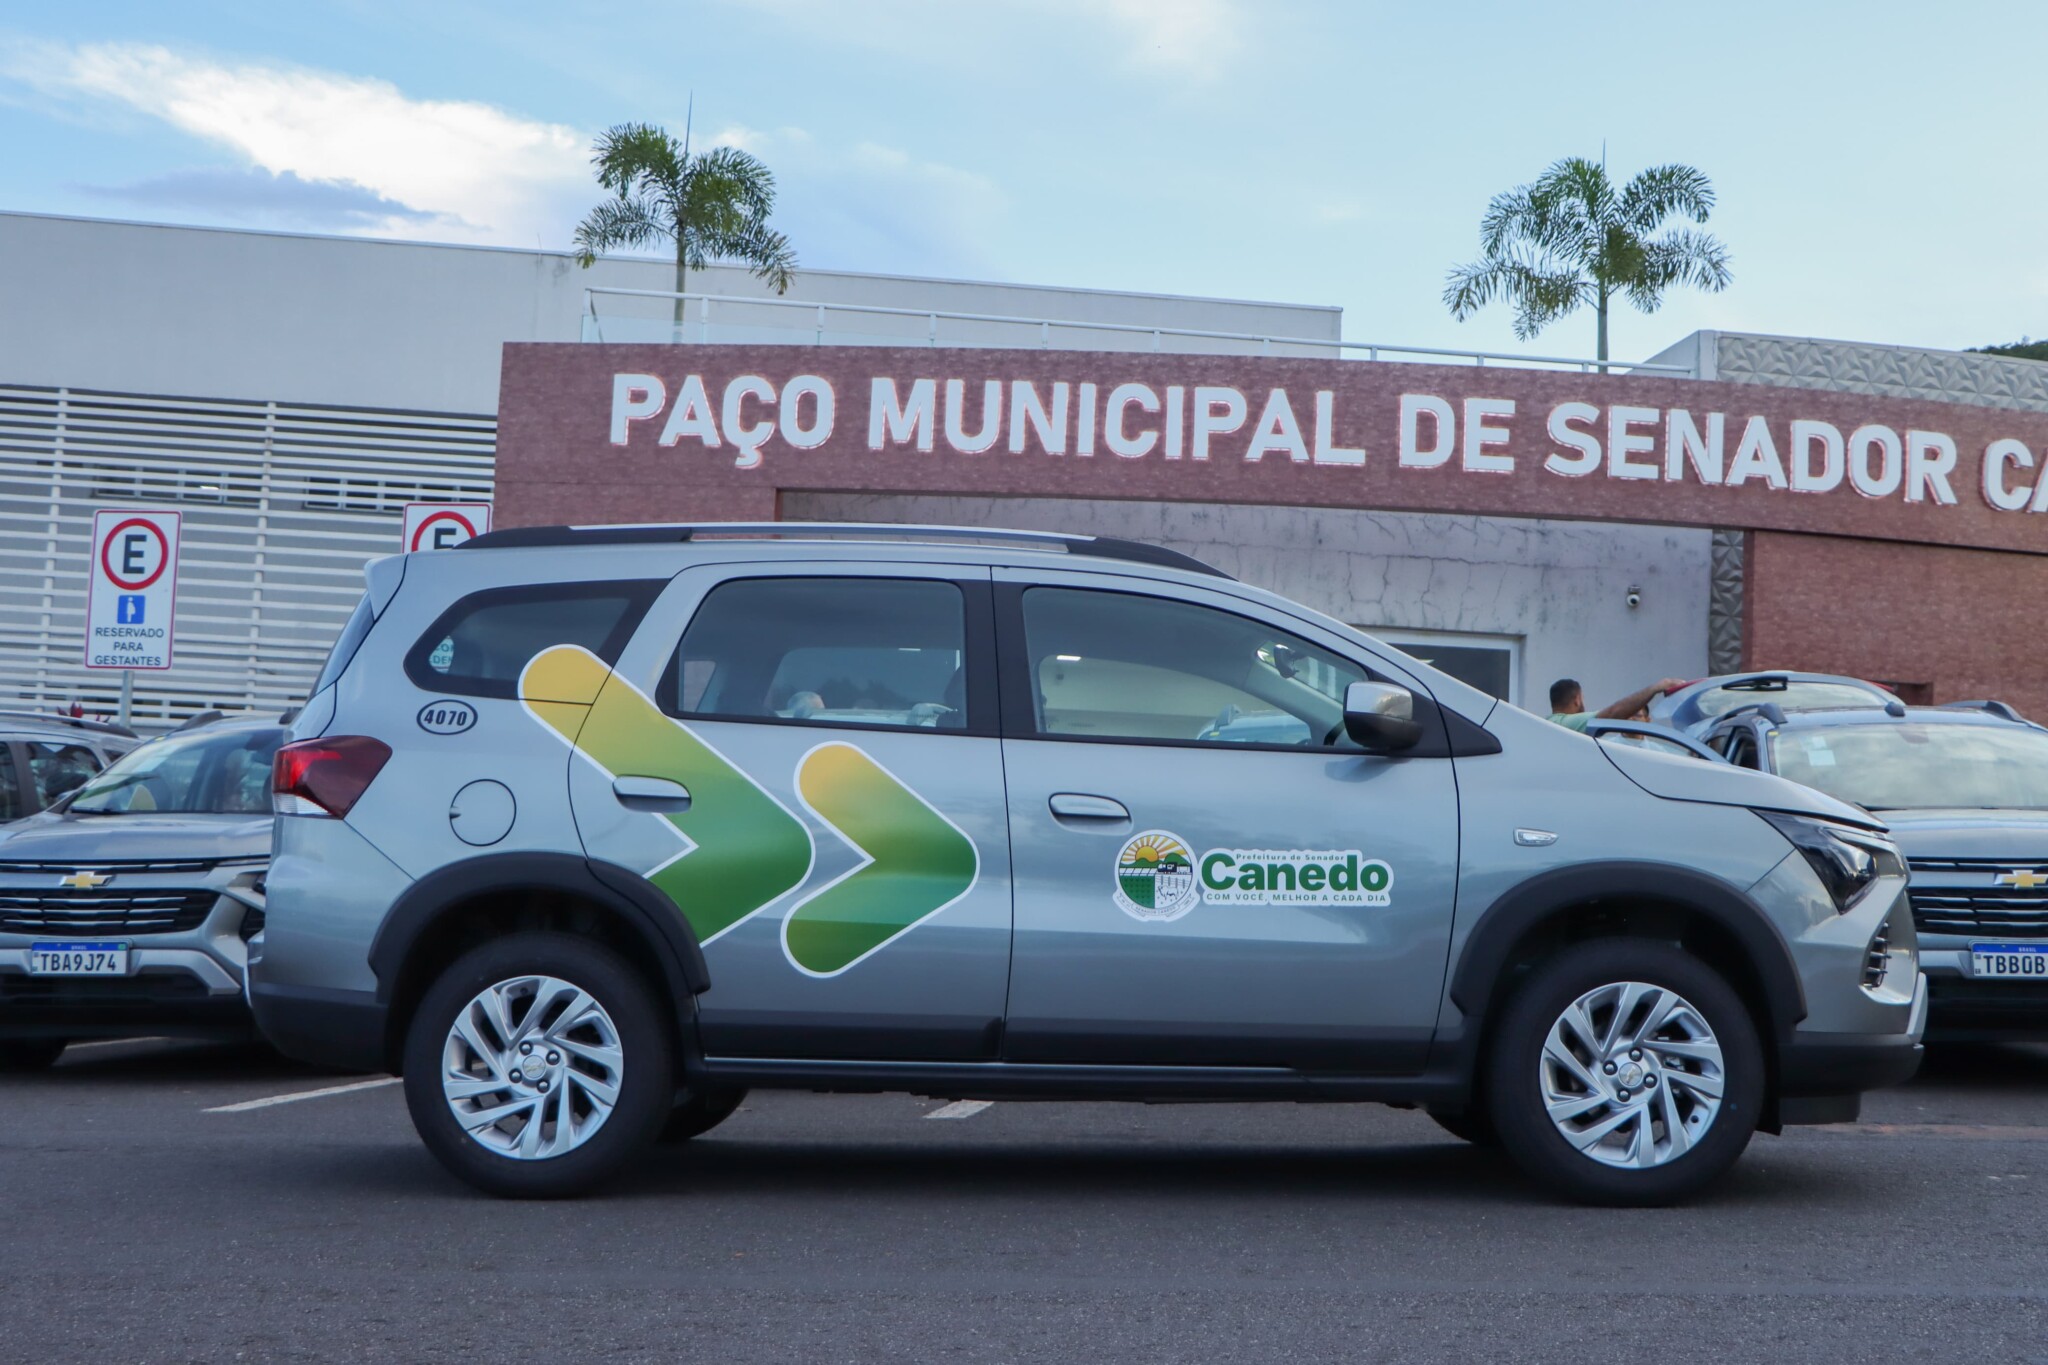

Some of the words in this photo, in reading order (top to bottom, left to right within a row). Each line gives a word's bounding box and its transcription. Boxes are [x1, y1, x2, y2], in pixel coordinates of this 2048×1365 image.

[609, 374, 835, 469] PAÇO
[867, 376, 1366, 467] MUNICIPAL
[1399, 393, 1516, 474] DE
[1543, 401, 1958, 506] SENADOR
[123, 534, 147, 574] E
[95, 628, 164, 638] RESERVADO
[113, 642, 144, 651] PARA
[95, 656, 161, 666] GESTANTES
[424, 710, 467, 726] 4070
[1201, 853, 1388, 891] Canedo
[1206, 893, 1231, 901] COM
[1333, 894, 1363, 902] CADA
[1367, 894, 1386, 902] DIA
[41, 954, 116, 971] TBA9J74
